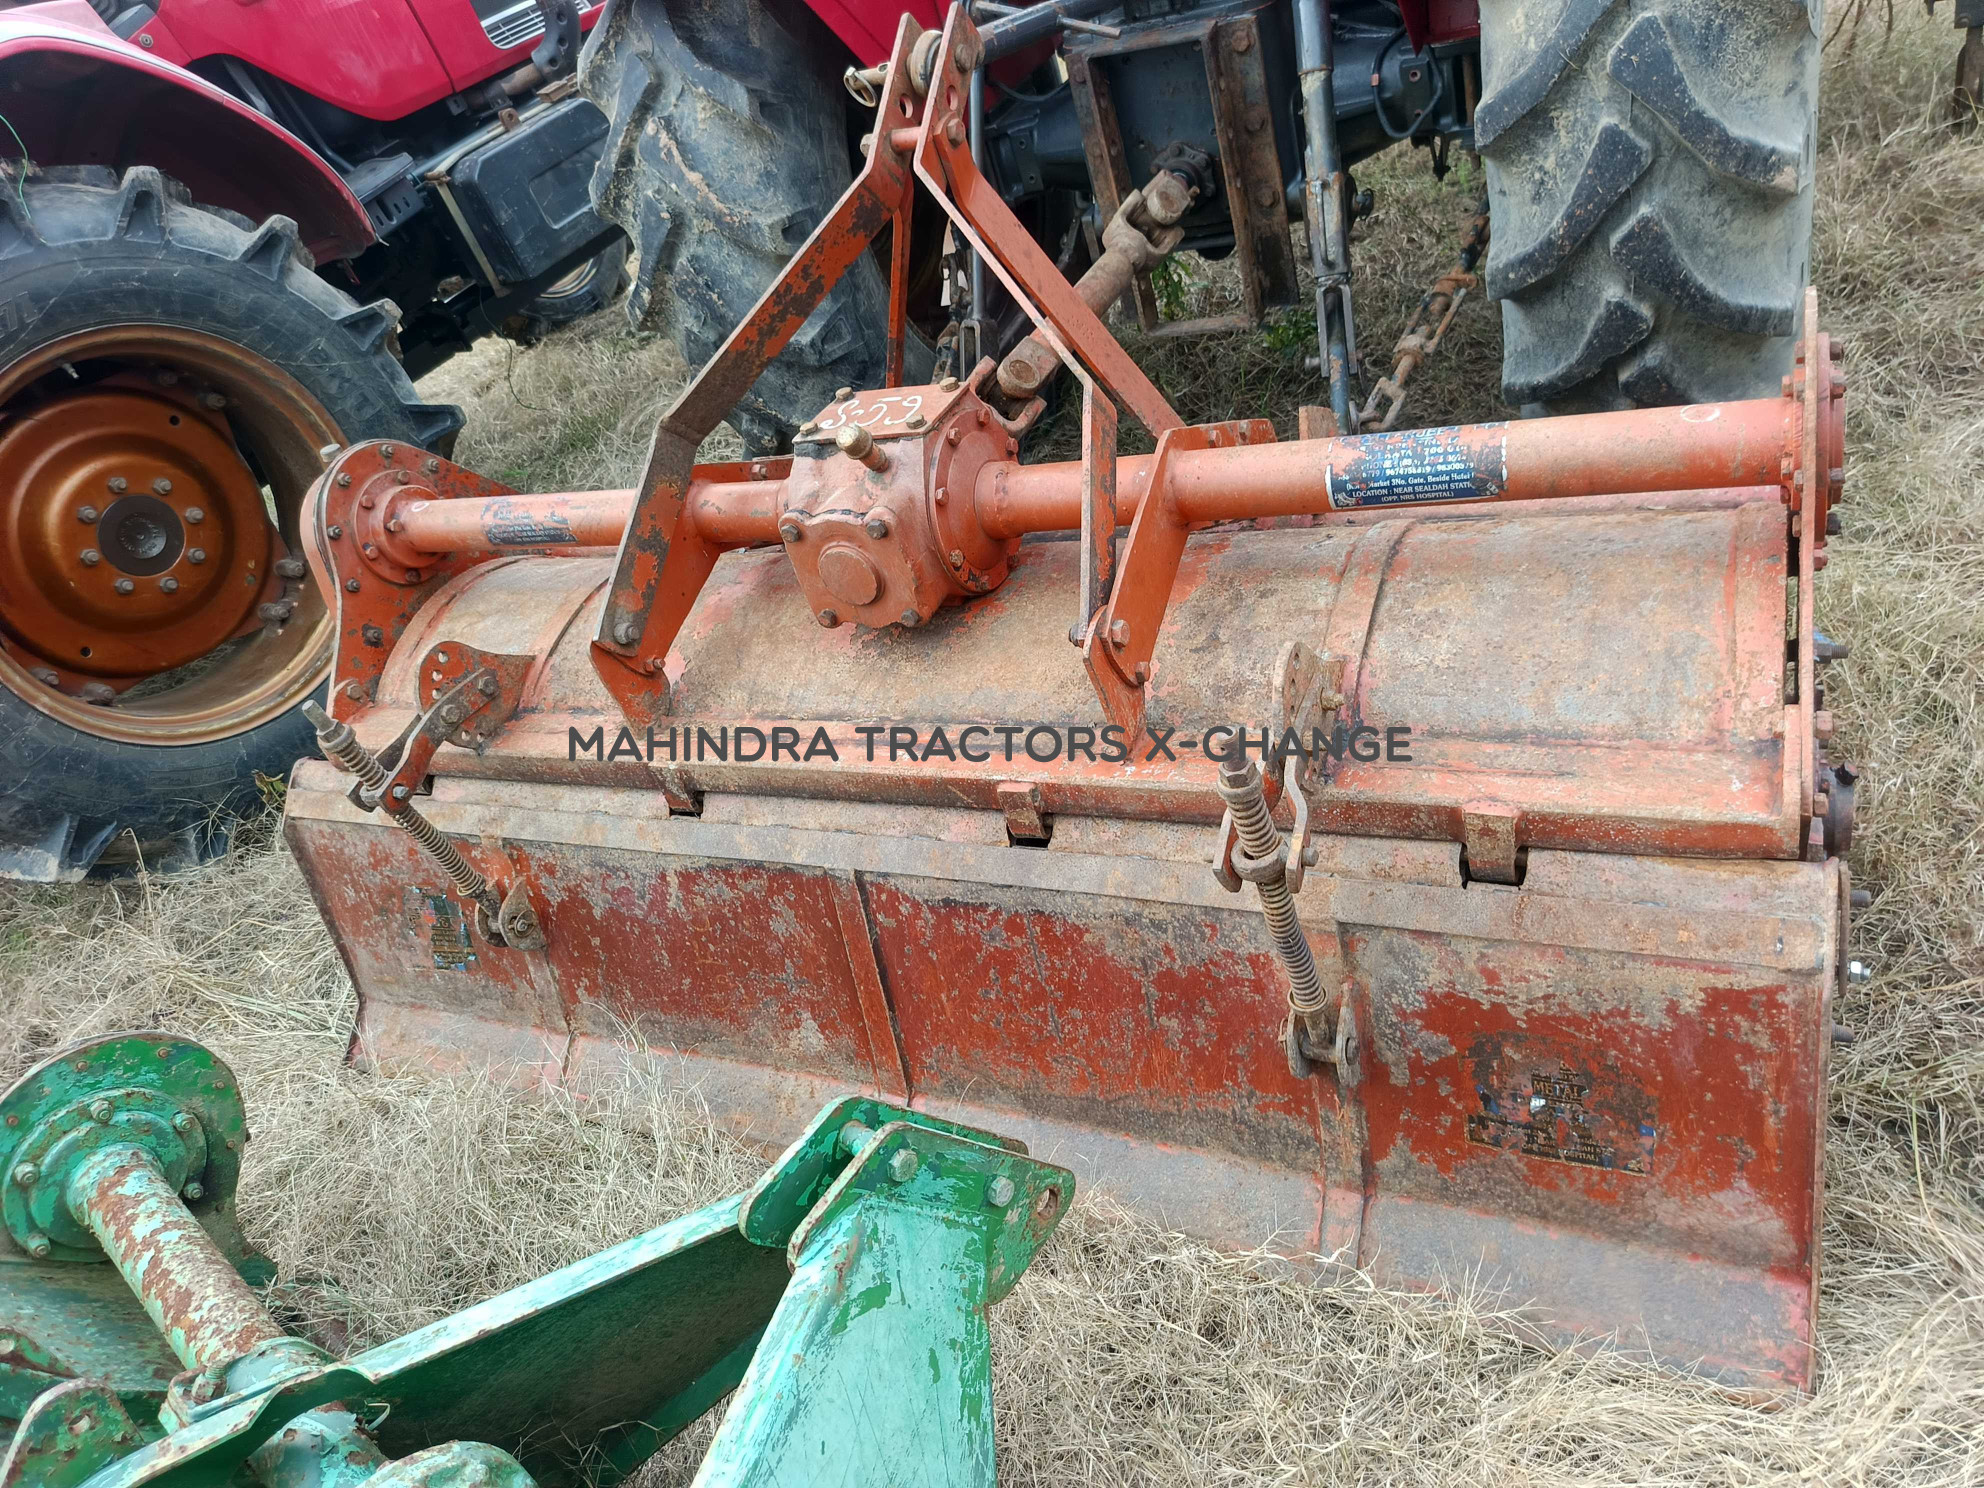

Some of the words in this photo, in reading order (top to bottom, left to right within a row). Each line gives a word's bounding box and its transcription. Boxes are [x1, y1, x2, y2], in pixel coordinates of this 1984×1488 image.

[1427, 474, 1449, 483] Beside
[1352, 489, 1388, 498] LOCATION
[1393, 486, 1413, 494] NEAR
[1415, 483, 1449, 492] SEALDAH
[1416, 491, 1454, 500] HOSPITAL)
